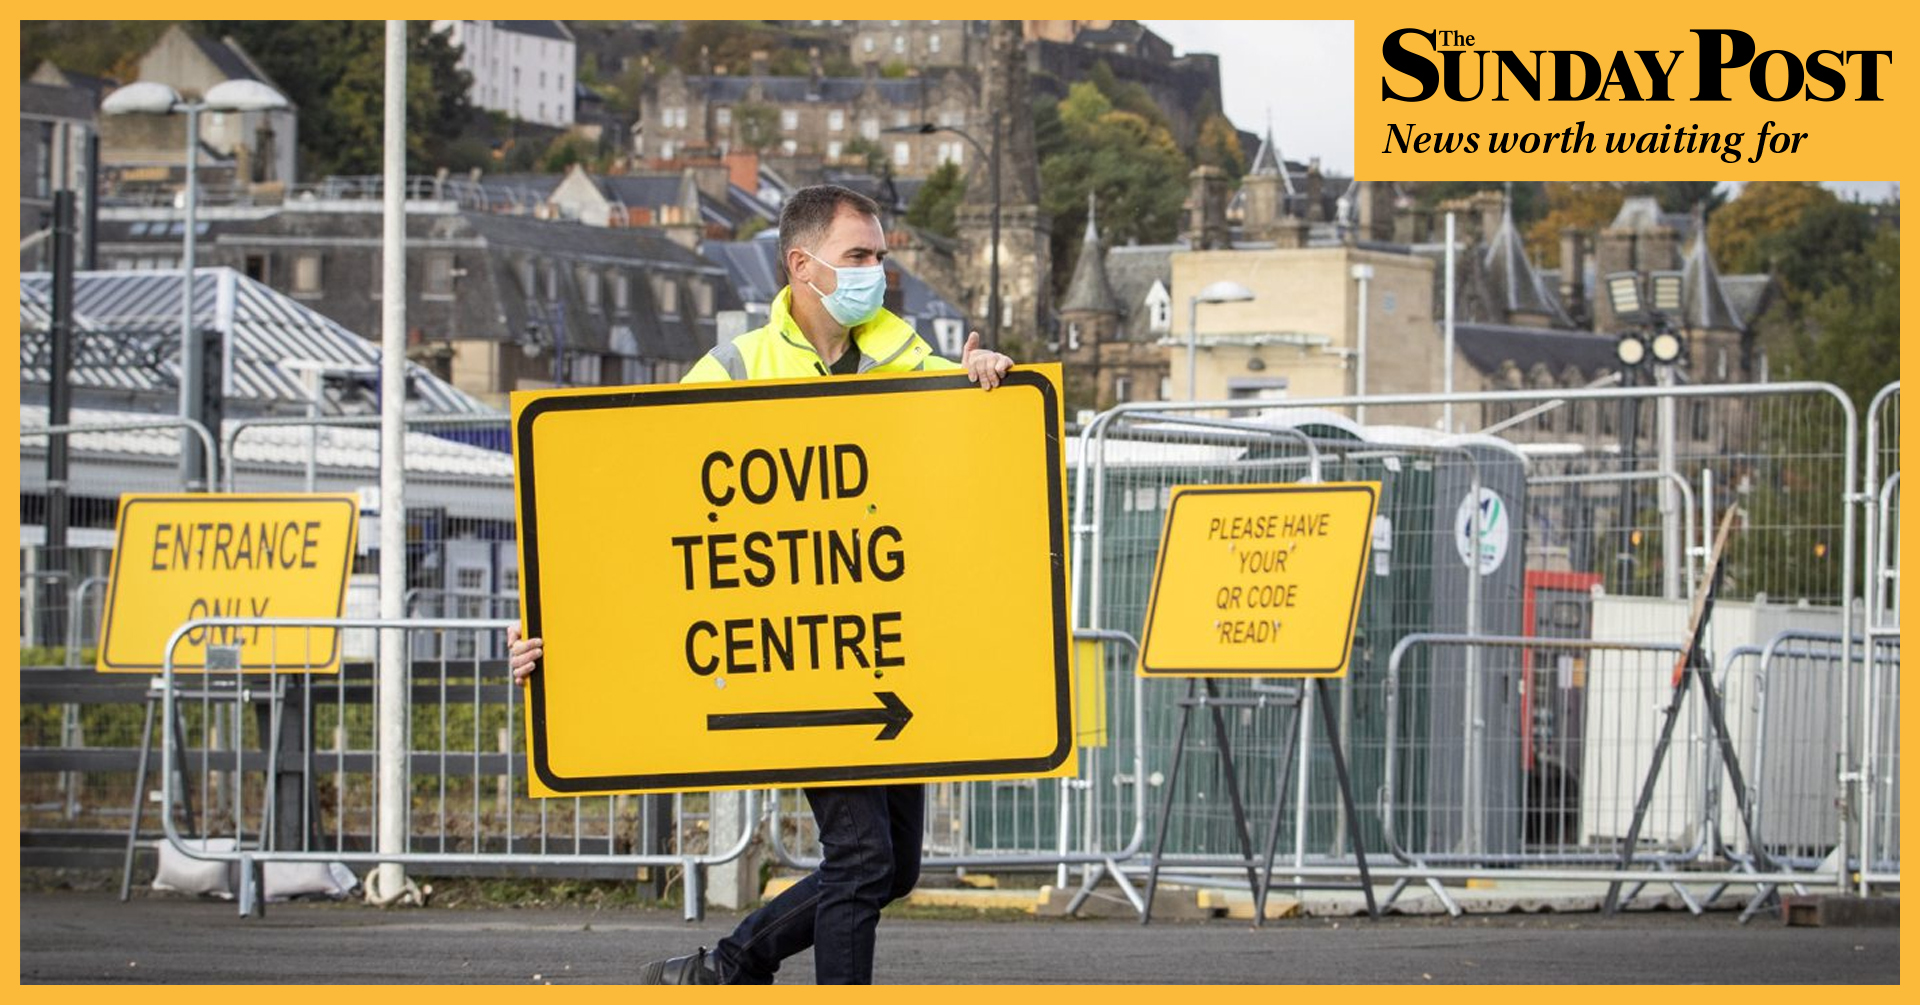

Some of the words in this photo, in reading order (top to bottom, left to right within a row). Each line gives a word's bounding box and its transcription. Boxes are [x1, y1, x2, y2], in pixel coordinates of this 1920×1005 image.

[701, 443, 869, 507] COVID
[151, 521, 321, 571] ENTRANCE
[1208, 516, 1278, 541] PLEASE
[1282, 513, 1330, 538] HAVE
[672, 526, 905, 590] TESTING
[1240, 550, 1288, 574] YOUR
[187, 597, 270, 647] ONLY
[1216, 587, 1242, 609] QR
[1247, 585, 1298, 608] CODE
[685, 612, 905, 676] CENTRE
[1219, 620, 1281, 645] READY
